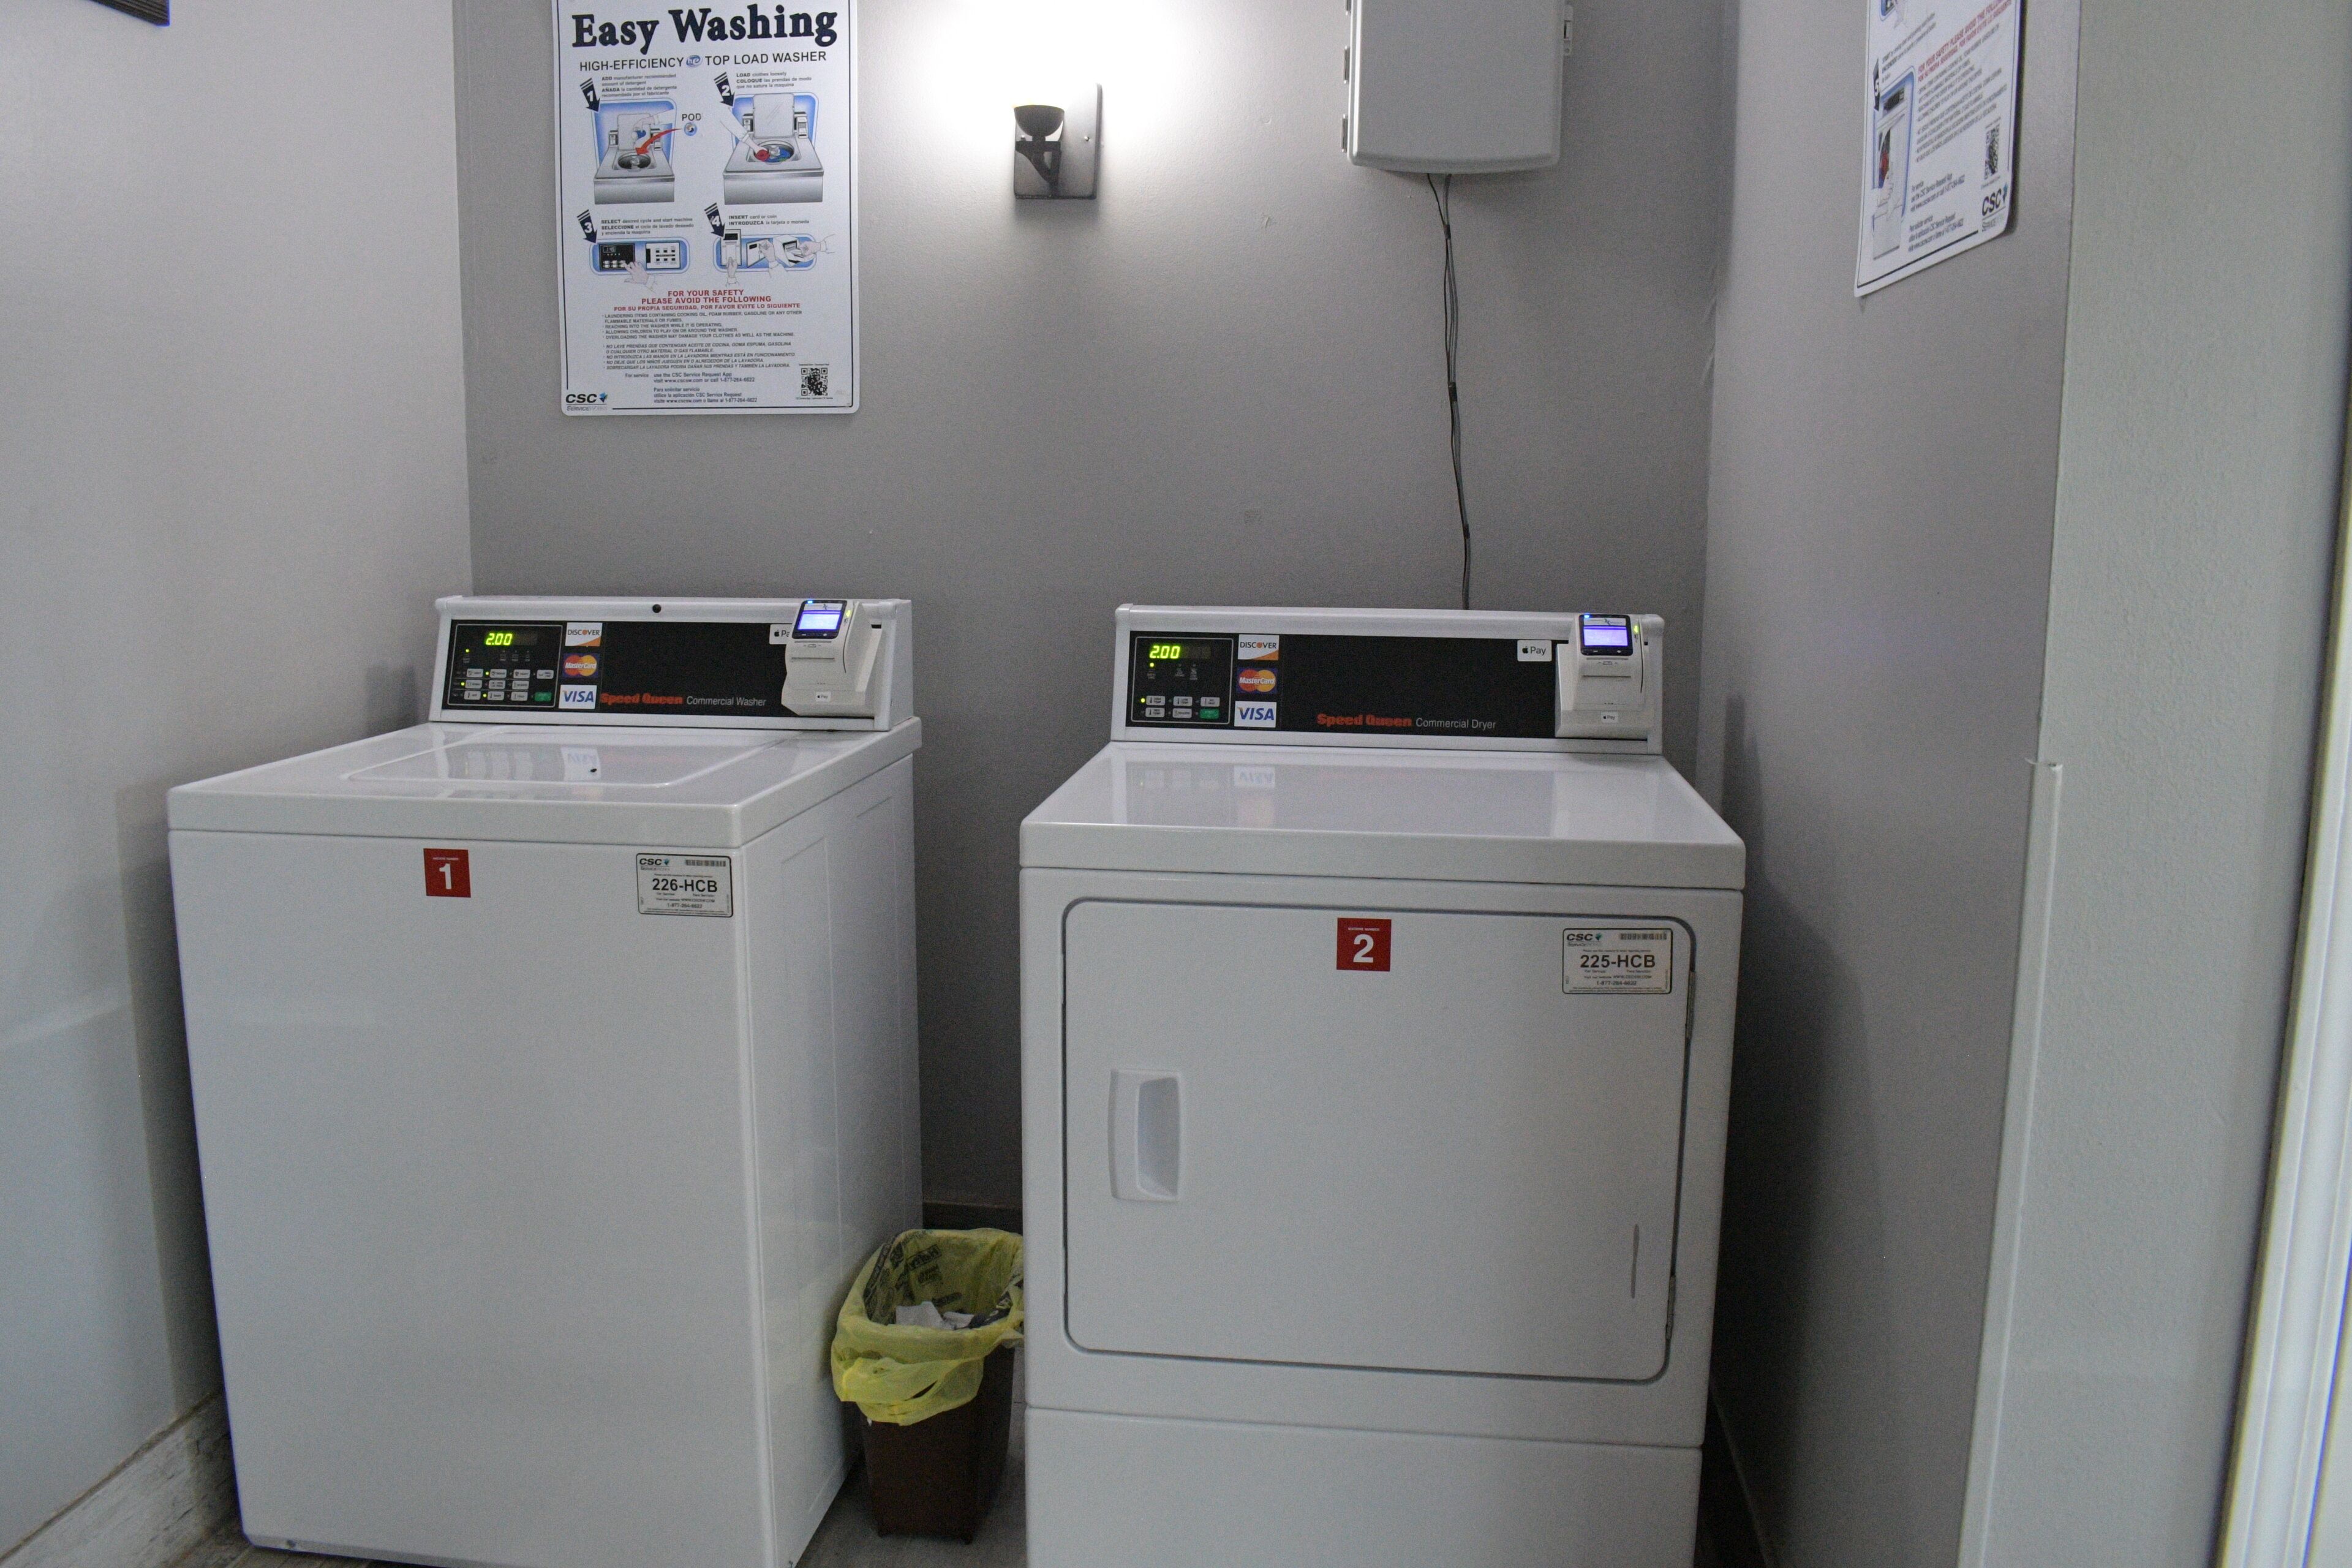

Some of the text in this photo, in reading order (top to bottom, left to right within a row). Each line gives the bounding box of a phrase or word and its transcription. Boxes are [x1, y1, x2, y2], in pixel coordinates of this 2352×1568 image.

[572, 4, 837, 55] Easy Washing
[580, 51, 826, 71] HIGH-EFFICIENCY TOP LOAD WASHER
[722, 85, 731, 96] 2
[1874, 78, 1880, 97] 5
[587, 91, 594, 102] 1
[682, 113, 701, 121] POD
[1982, 189, 2002, 216] CSC
[584, 222, 592, 233] 3
[710, 216, 720, 226] 4
[565, 394, 597, 403] CSC
[486, 633, 513, 646] 2.00
[1150, 646, 1180, 659] 2.00
[1531, 647, 1546, 655] Pay
[562, 690, 594, 703] VISA
[600, 693, 766, 707] Speed Queen Commercial Washer
[1238, 707, 1274, 720] VISA
[1317, 713, 1496, 731] Speed Queen Commercial Dryer
[439, 863, 451, 889] 1
[652, 878, 717, 892] 226-HCB
[1353, 934, 1374, 963] 2
[1580, 955, 1655, 968] 225-HCB
